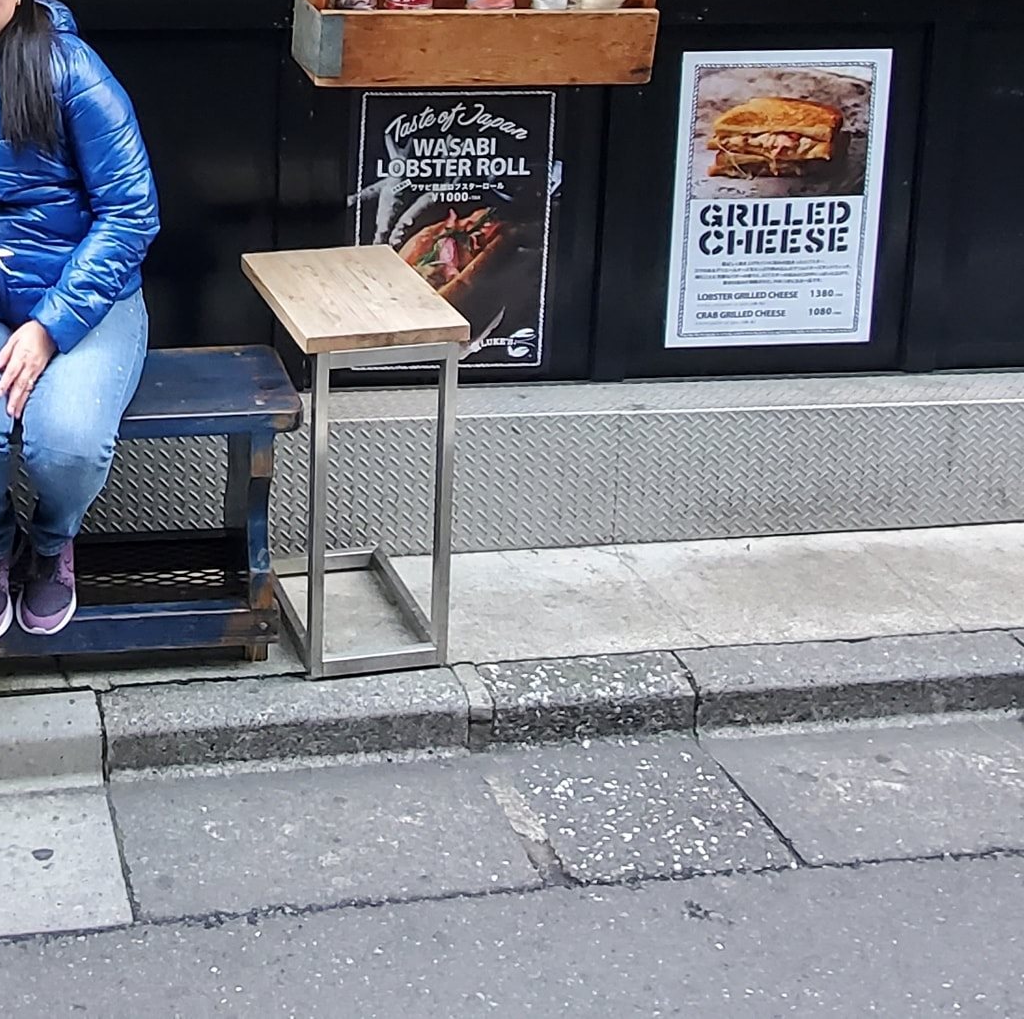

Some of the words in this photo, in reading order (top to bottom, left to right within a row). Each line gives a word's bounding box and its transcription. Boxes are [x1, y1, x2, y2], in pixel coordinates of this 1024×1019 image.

[385, 106, 437, 143] Taste
[437, 102, 466, 132] of
[457, 103, 529, 140] Japan
[412, 137, 496, 157] WASABI
[377, 158, 473, 178] LOBSTER
[476, 157, 531, 177] ROLL
[699, 200, 852, 228] GRILLED
[698, 227, 850, 256] CHEESE
[697, 292, 733, 301] LOBSTER
[734, 291, 767, 300] GRILLED
[768, 290, 799, 299] CHEESE
[810, 289, 834, 298] 1380
[696, 311, 719, 320] CRAB
[720, 310, 754, 319] GRILLED
[755, 309, 787, 318] CHEESE
[808, 308, 832, 316] 1080
